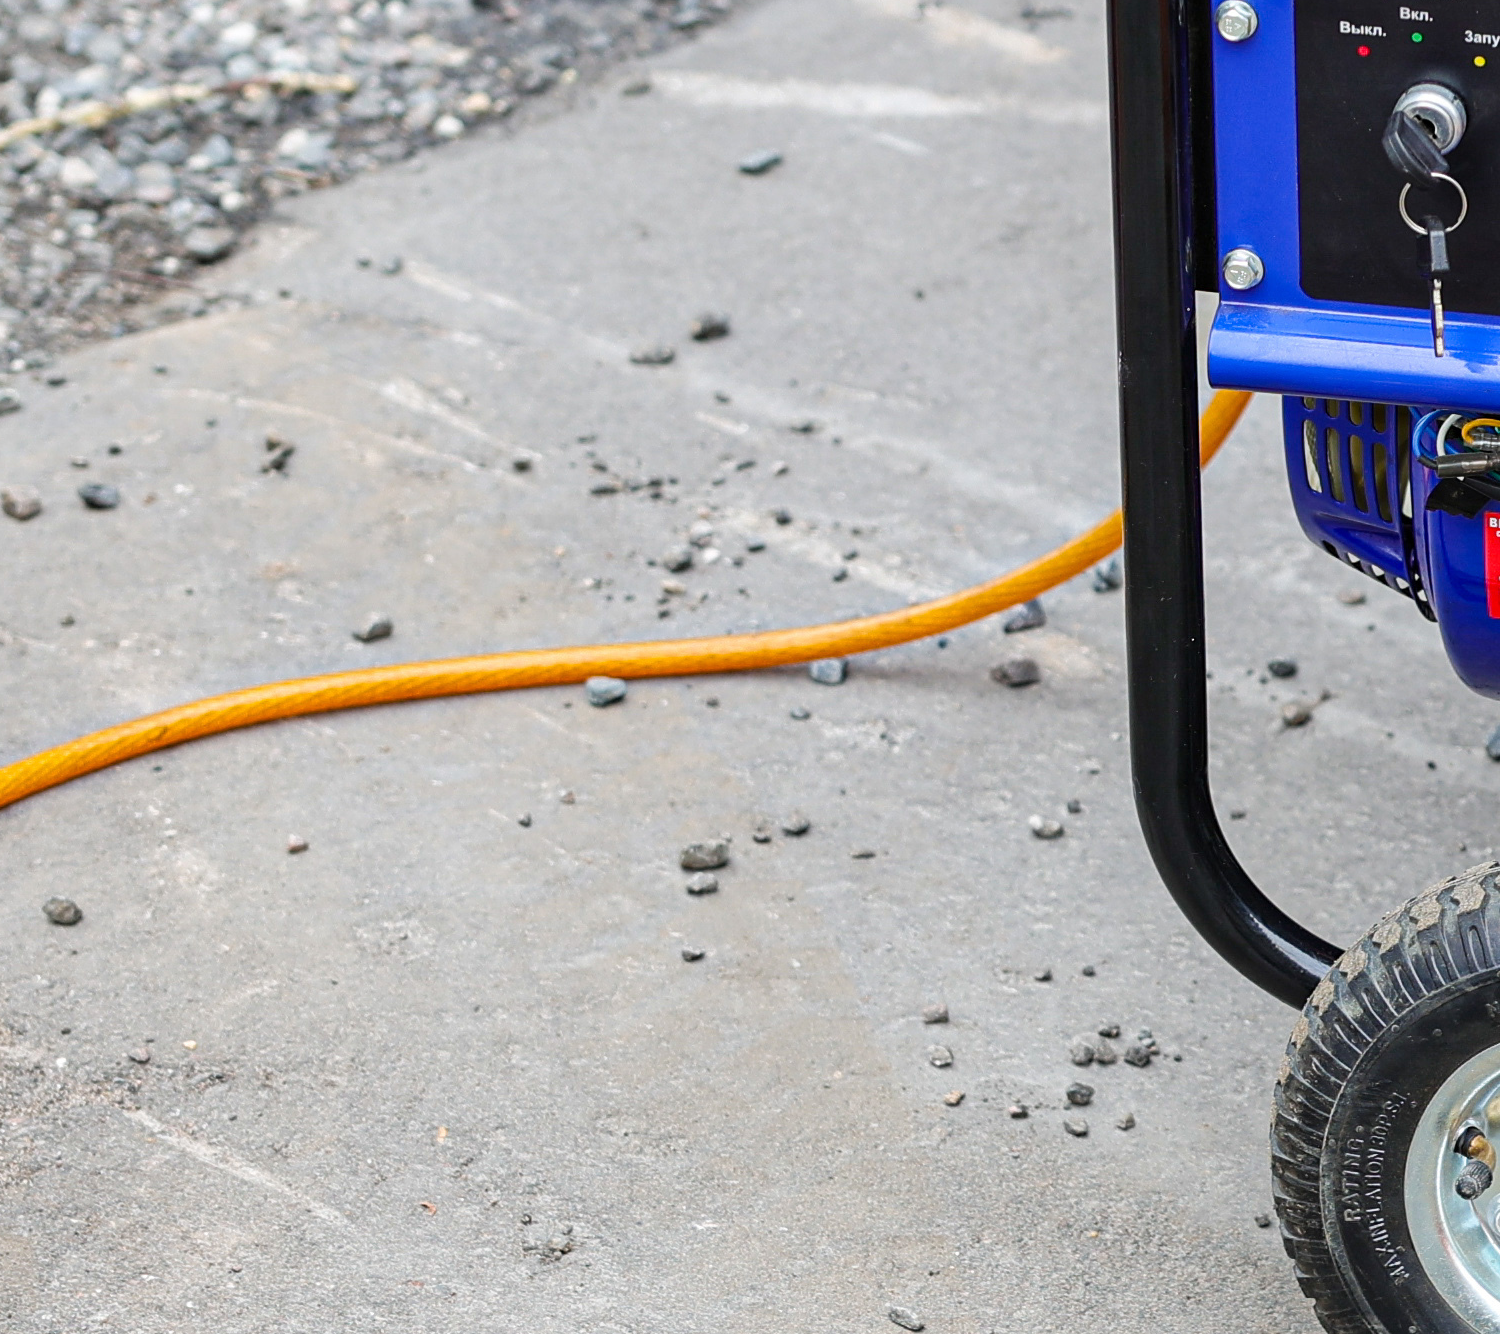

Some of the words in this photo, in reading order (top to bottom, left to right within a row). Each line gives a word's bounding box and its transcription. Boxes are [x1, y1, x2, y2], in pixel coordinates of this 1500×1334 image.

[1400, 7, 1434, 22] Вкл.
[1339, 21, 1388, 37] Выкл.
[1342, 1138, 1364, 1222] RATING
